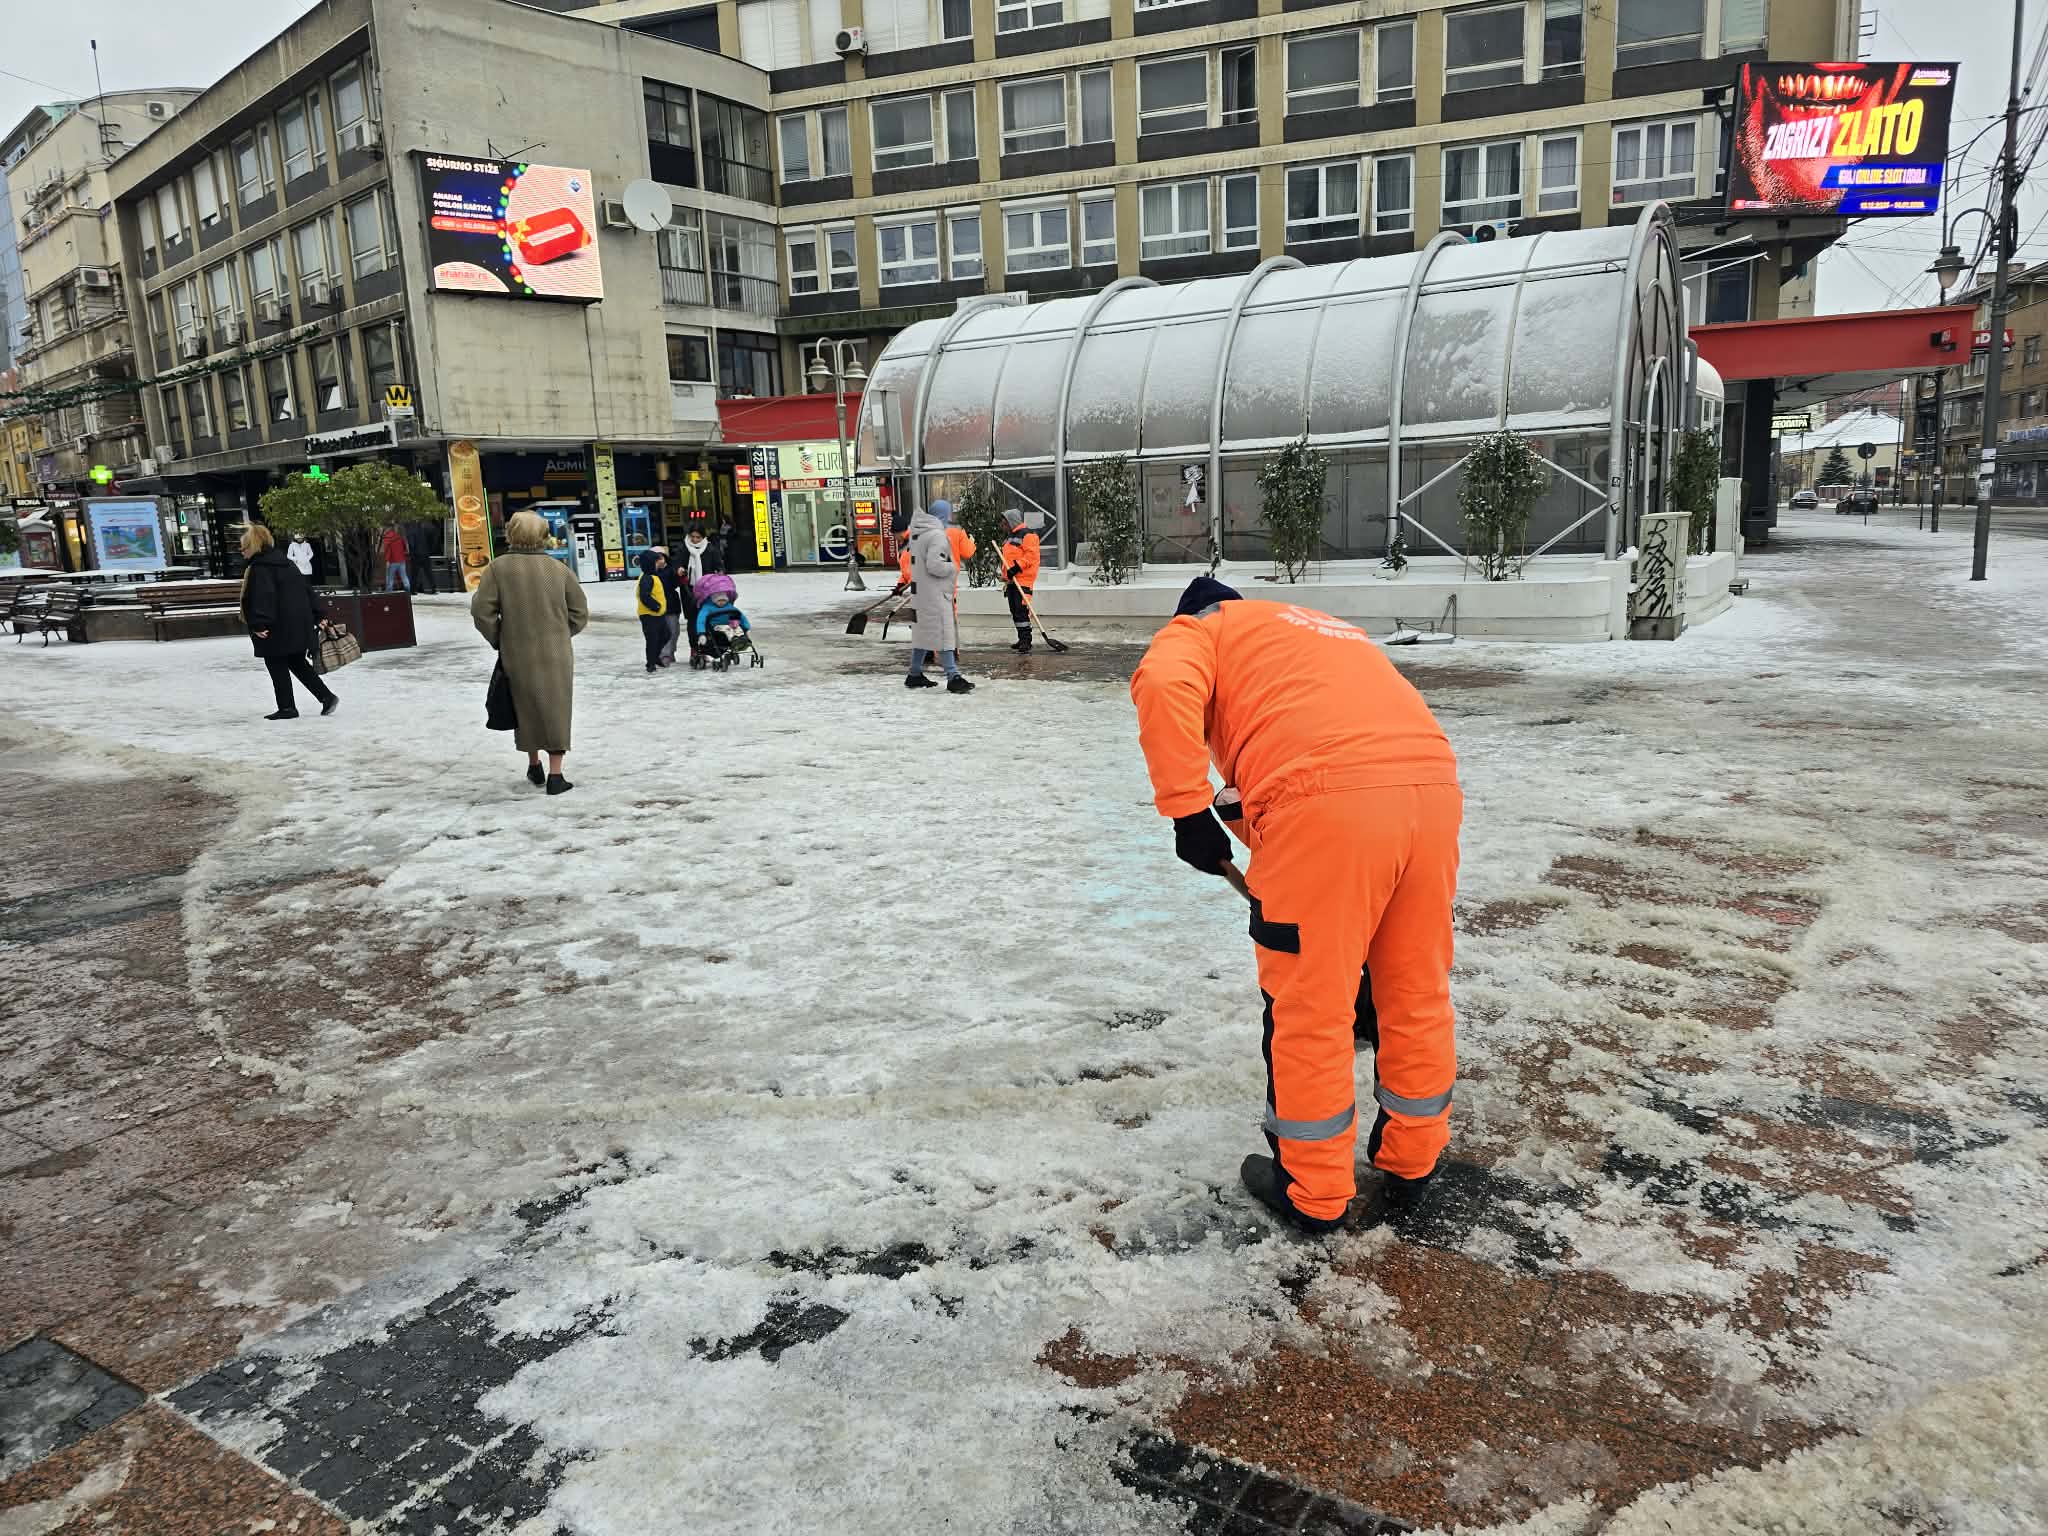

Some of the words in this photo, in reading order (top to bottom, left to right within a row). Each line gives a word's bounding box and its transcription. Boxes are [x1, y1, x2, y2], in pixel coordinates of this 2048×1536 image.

[1762, 115, 1834, 160] ZAGRIZI
[1832, 99, 1924, 157] ZLATO
[426, 157, 472, 172] SIGURNO
[753, 451, 764, 476] 08-22
